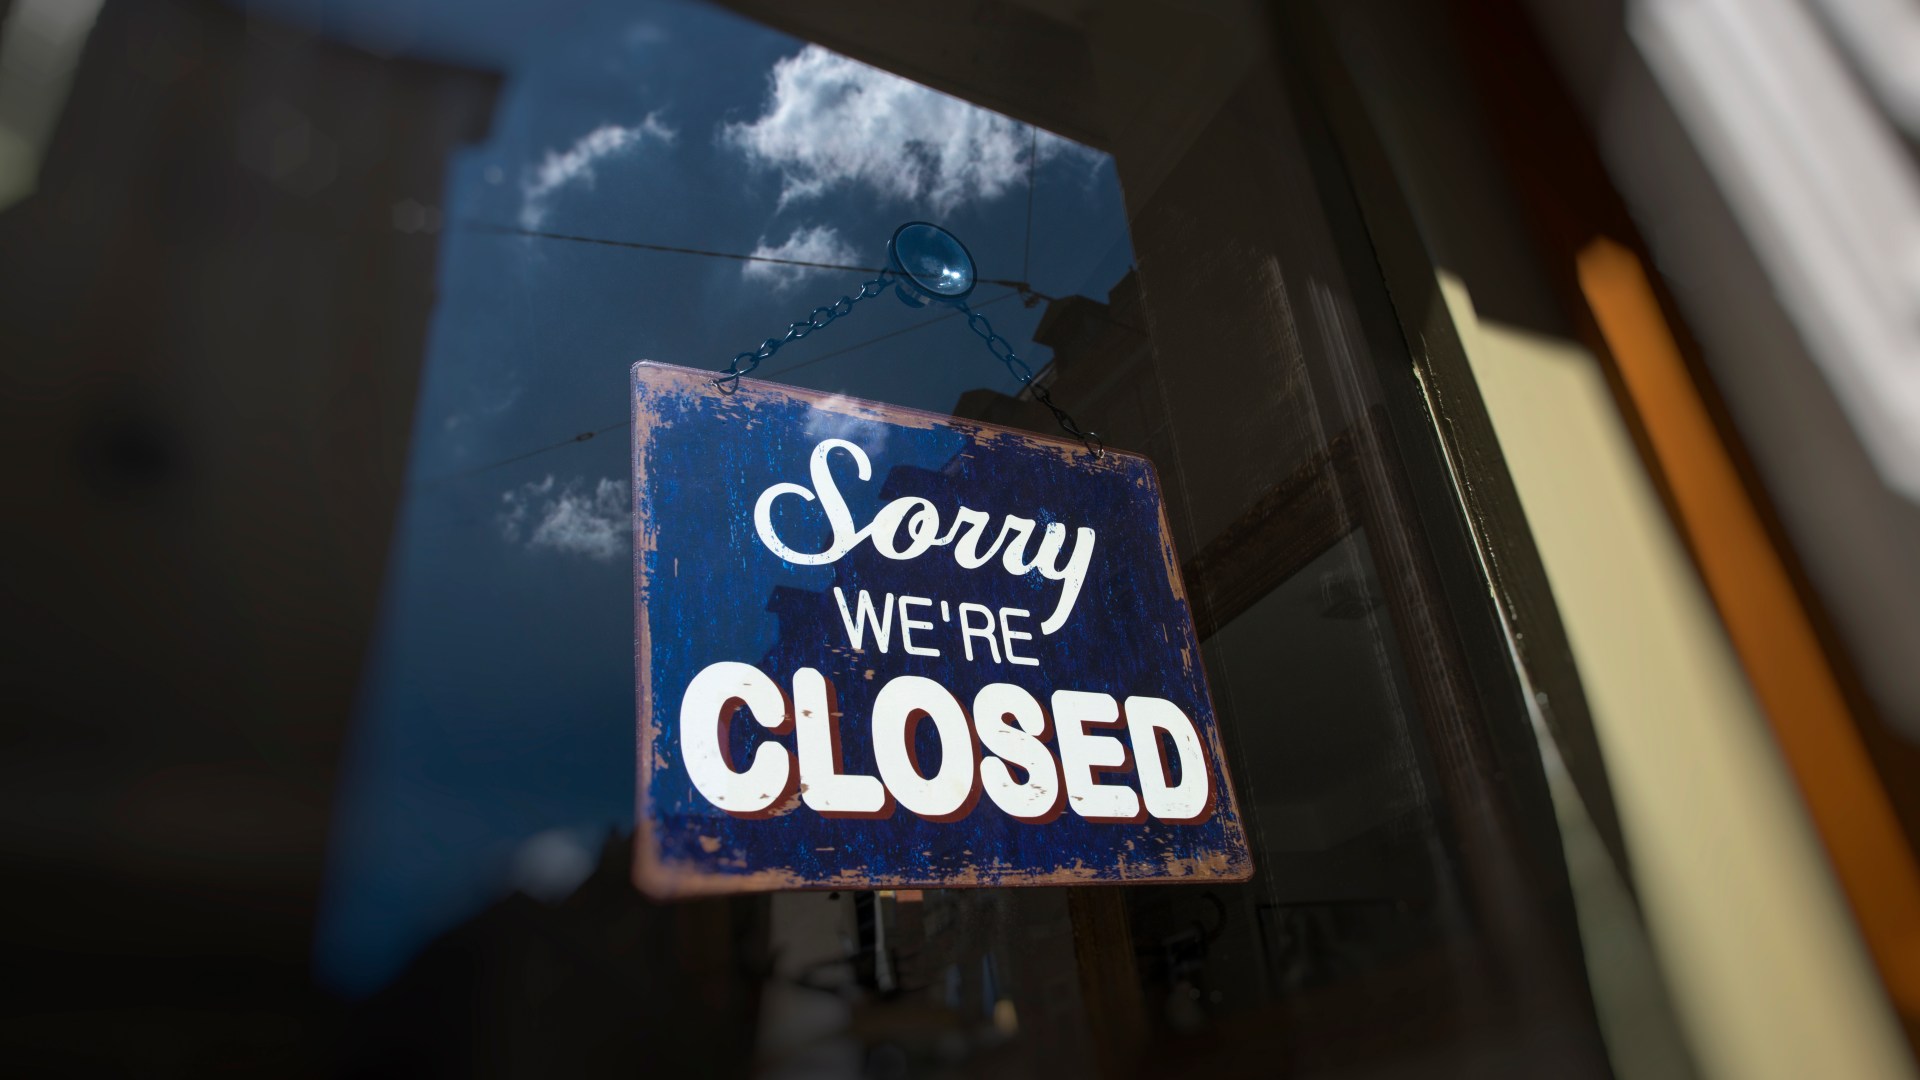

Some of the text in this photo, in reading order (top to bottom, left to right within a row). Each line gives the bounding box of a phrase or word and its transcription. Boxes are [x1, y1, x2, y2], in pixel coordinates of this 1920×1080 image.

[754, 438, 1096, 635] Sorry
[833, 587, 1040, 666] WE'RE
[680, 661, 1210, 820] CLOSED
